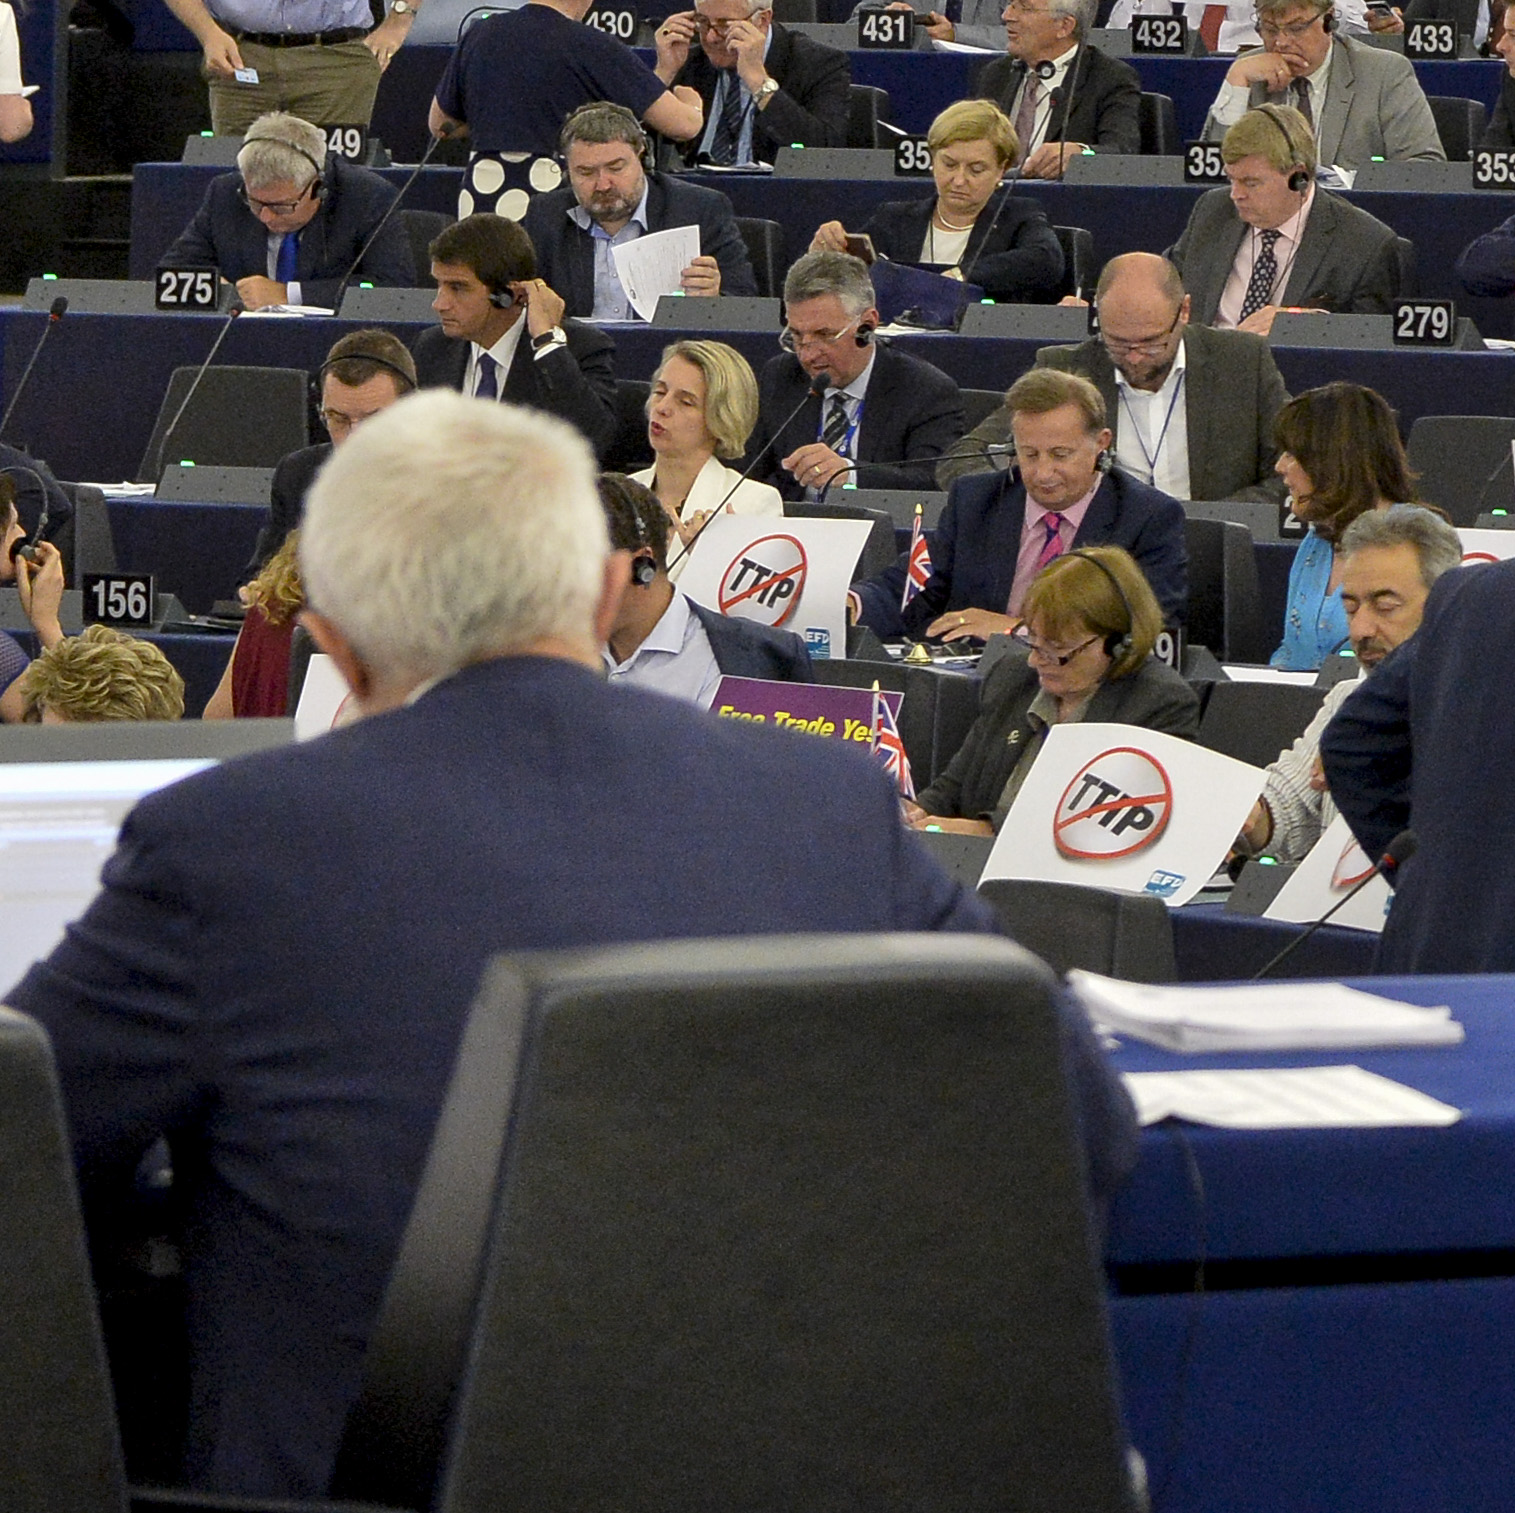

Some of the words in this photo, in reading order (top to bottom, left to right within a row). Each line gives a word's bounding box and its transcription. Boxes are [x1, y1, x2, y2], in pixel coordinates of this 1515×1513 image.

[586, 11, 635, 39] 430
[863, 16, 906, 43] 431
[1136, 22, 1182, 47] 432
[1408, 26, 1454, 52] 433
[899, 140, 931, 169] 35
[1189, 147, 1227, 175] 35
[160, 271, 213, 305] 275
[1397, 305, 1449, 340] 279
[92, 579, 147, 618] 156
[728, 557, 795, 609] TTIP
[772, 709, 836, 739] Trade
[842, 718, 877, 744] Yes
[1066, 772, 1156, 838] TTIP
